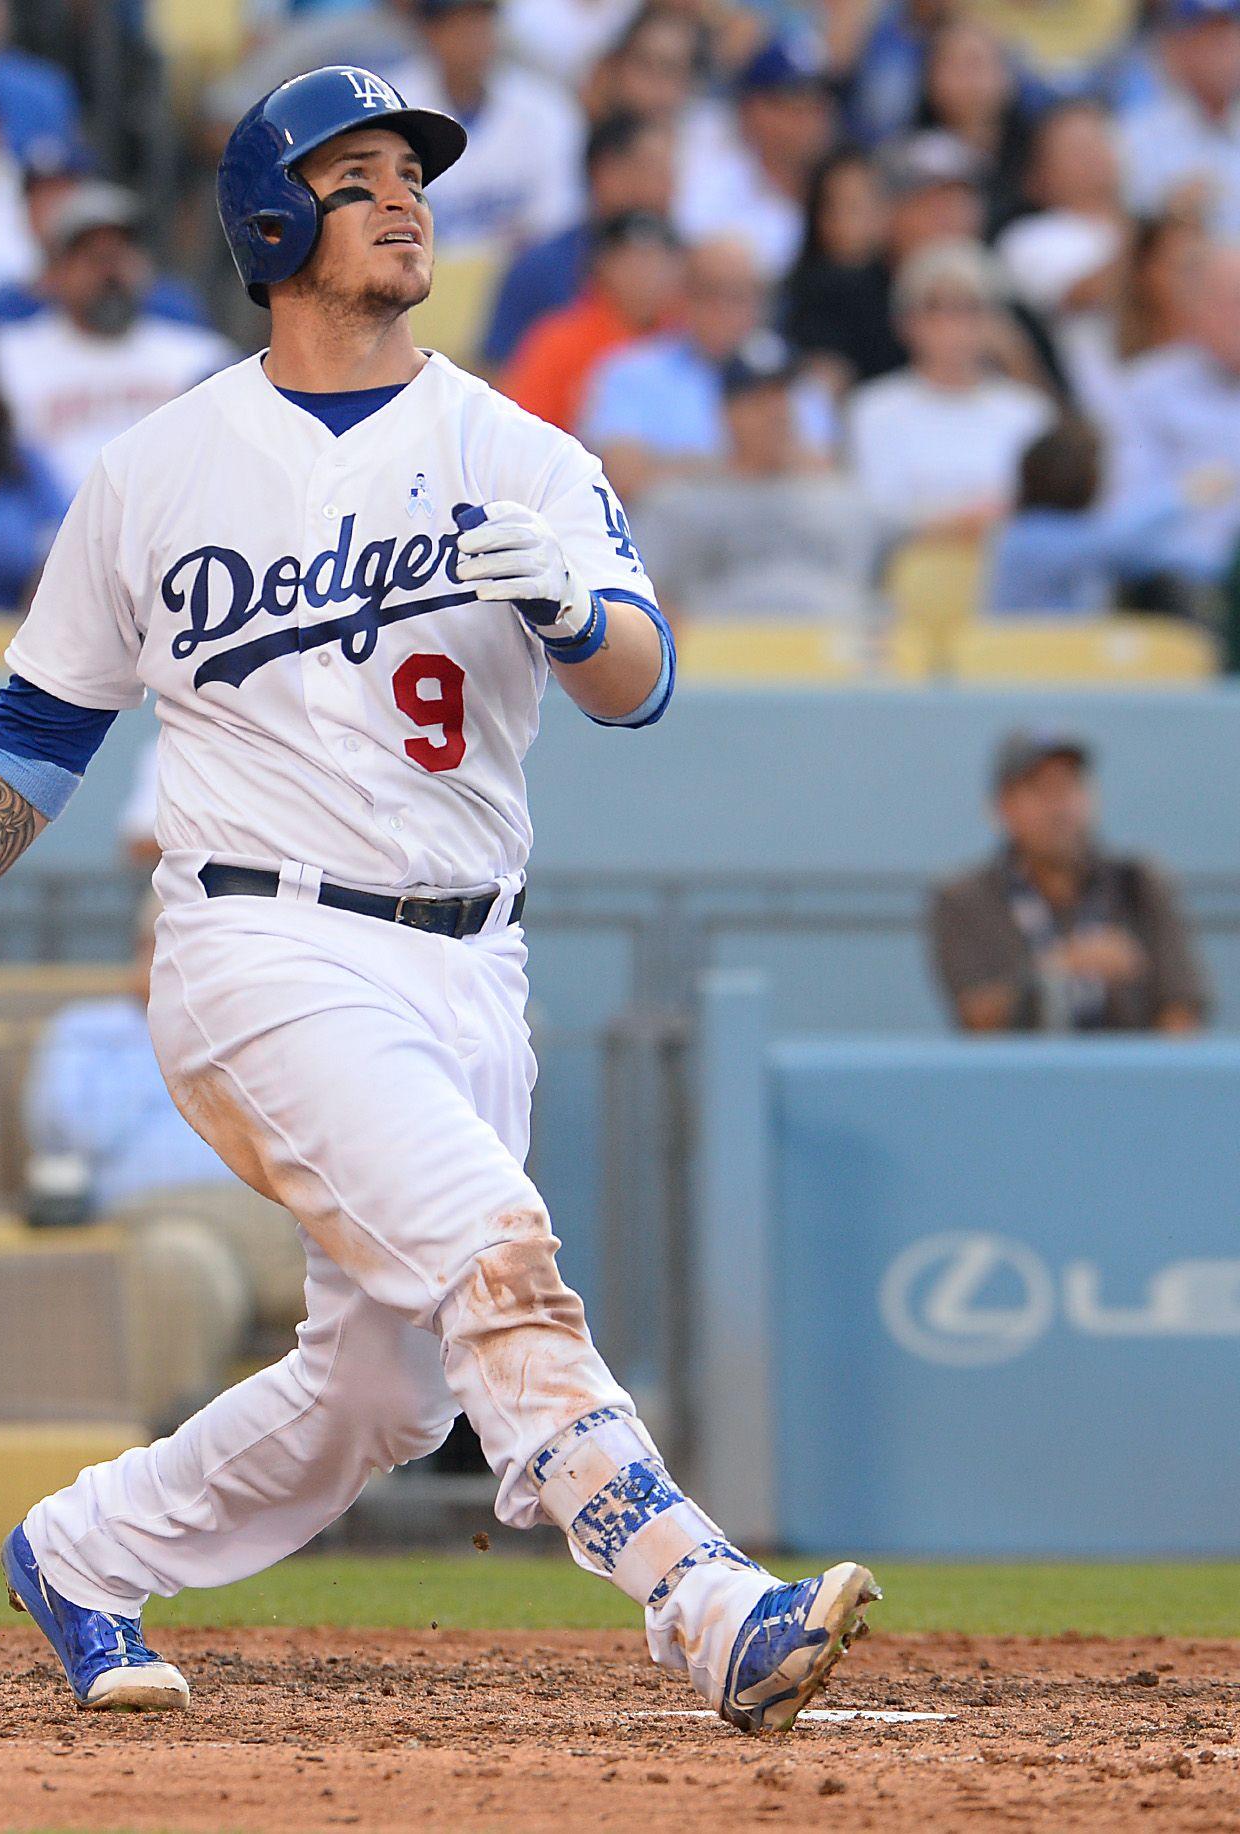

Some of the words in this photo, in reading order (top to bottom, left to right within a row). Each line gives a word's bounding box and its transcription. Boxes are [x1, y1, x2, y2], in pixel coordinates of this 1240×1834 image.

[340, 71, 400, 110] LA
[592, 484, 646, 574] LA
[161, 503, 479, 665] Dodger
[391, 653, 466, 773] 9
